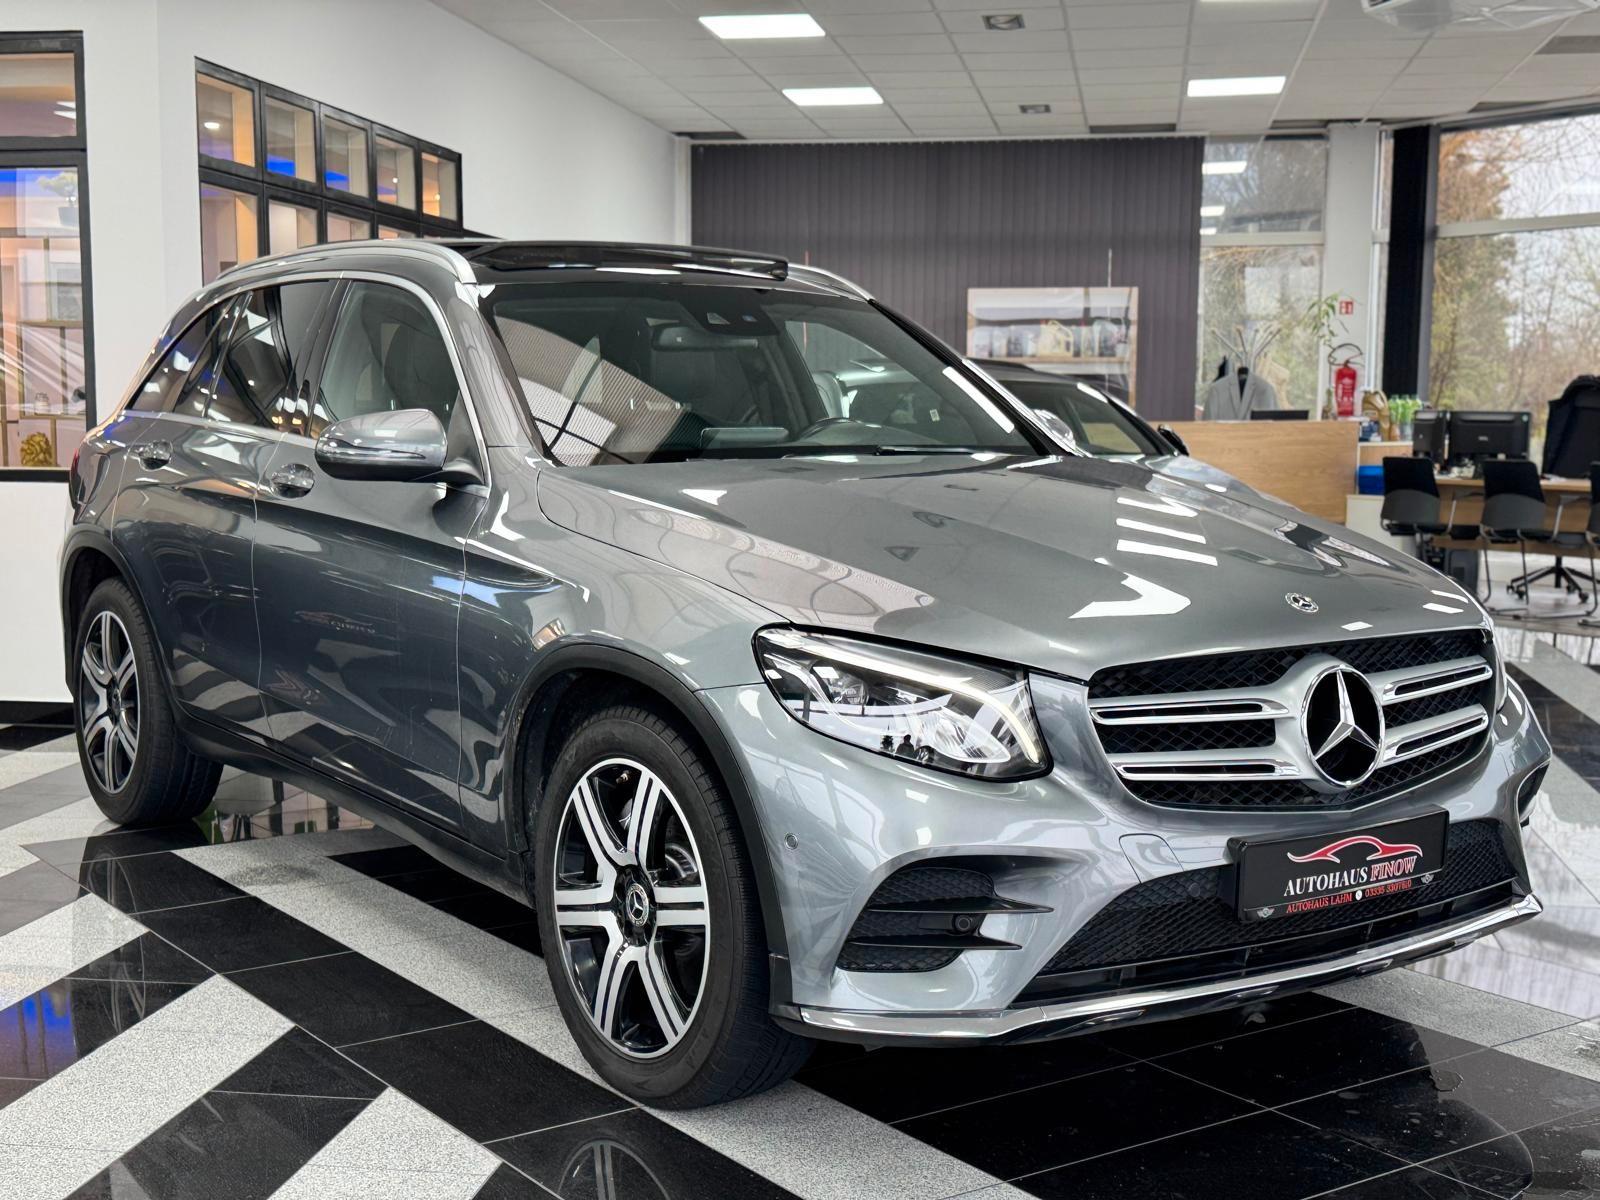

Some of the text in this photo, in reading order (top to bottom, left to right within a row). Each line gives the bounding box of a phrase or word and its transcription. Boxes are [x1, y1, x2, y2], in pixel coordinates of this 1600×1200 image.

[1284, 856, 1417, 896] AUTOHAUS FINOW
[1286, 897, 1329, 914] AUTOHAUS
[1330, 892, 1353, 905] LAHM
